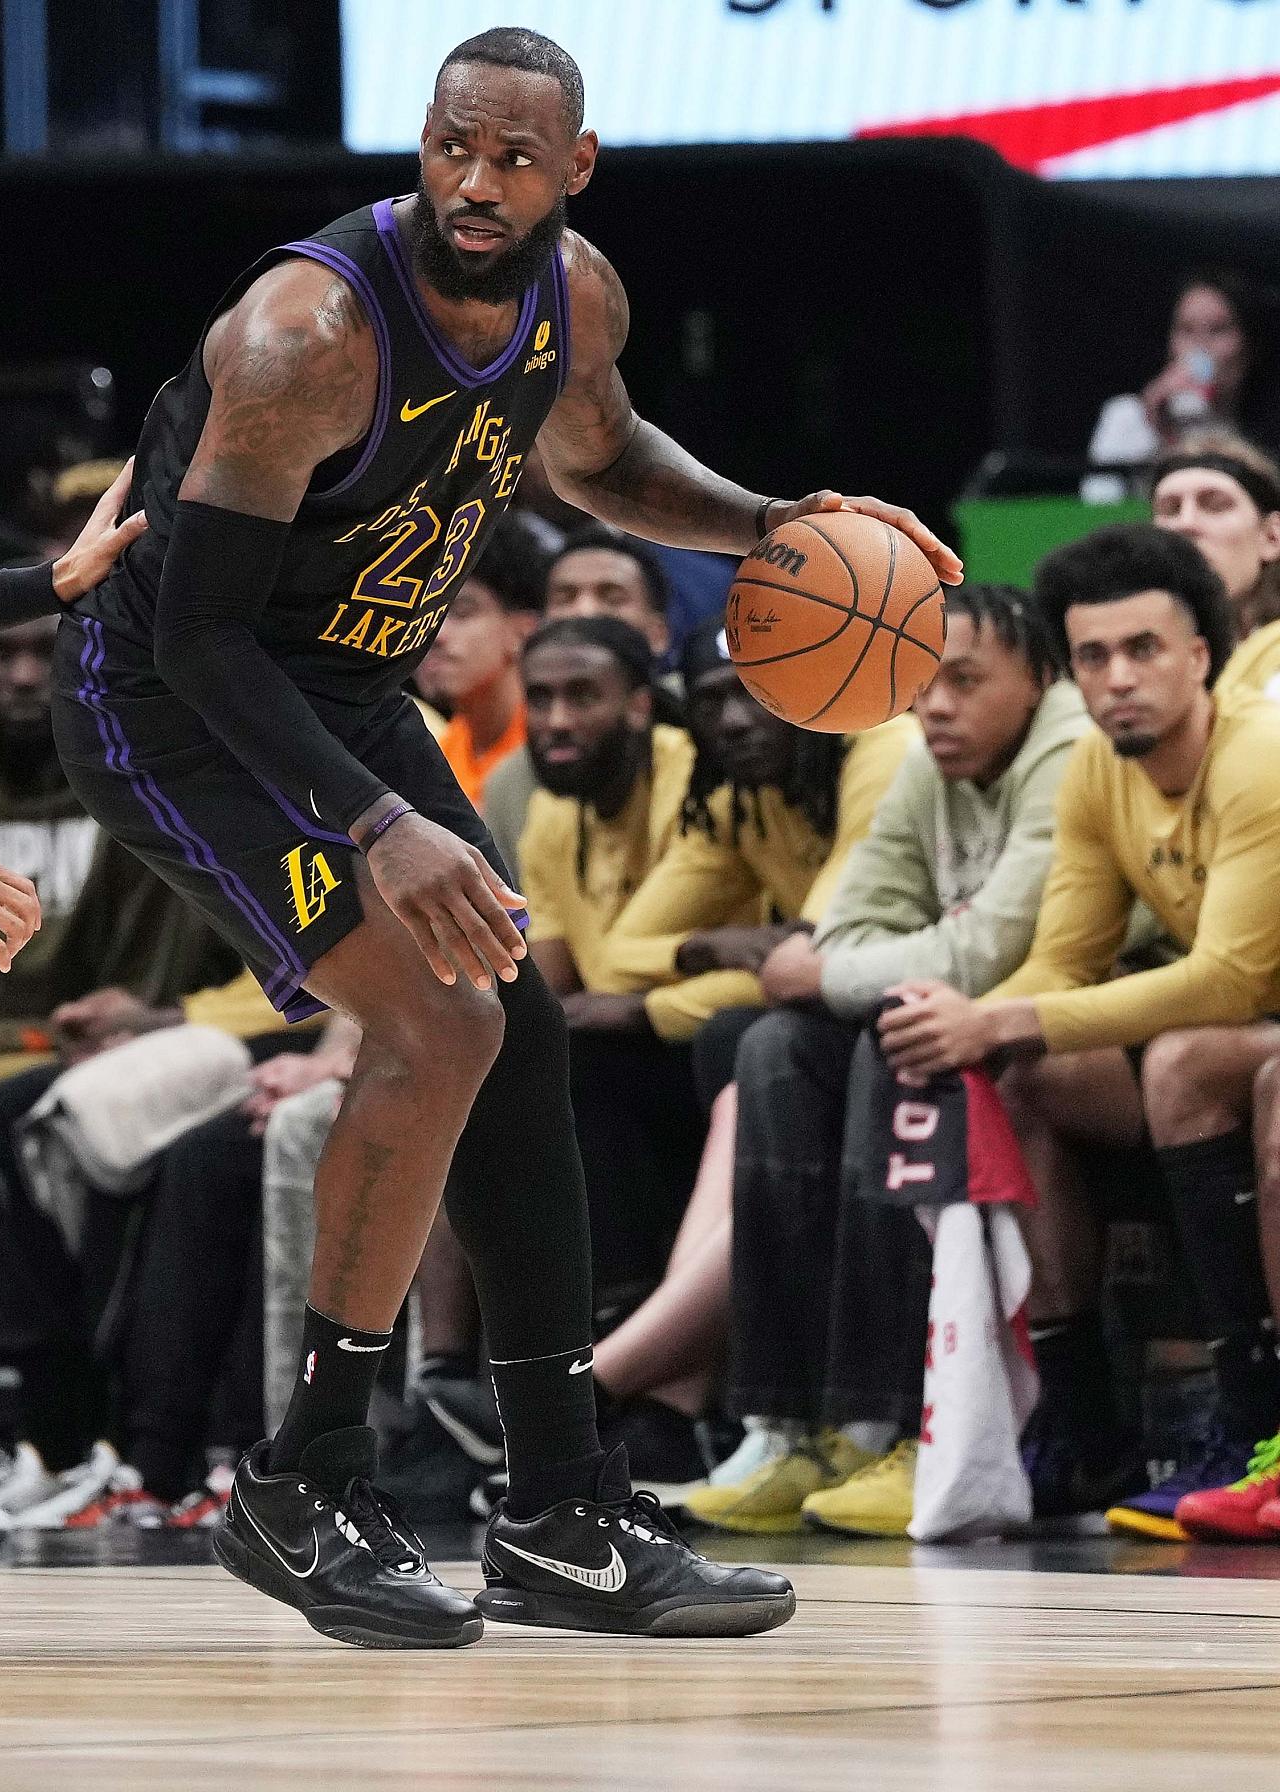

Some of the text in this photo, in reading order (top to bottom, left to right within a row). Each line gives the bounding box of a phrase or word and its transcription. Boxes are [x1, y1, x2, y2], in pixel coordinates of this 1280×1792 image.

[524, 350, 556, 375] bibigo
[444, 400, 523, 512] ANGELE
[350, 498, 486, 610] 23
[280, 842, 342, 934] LA
